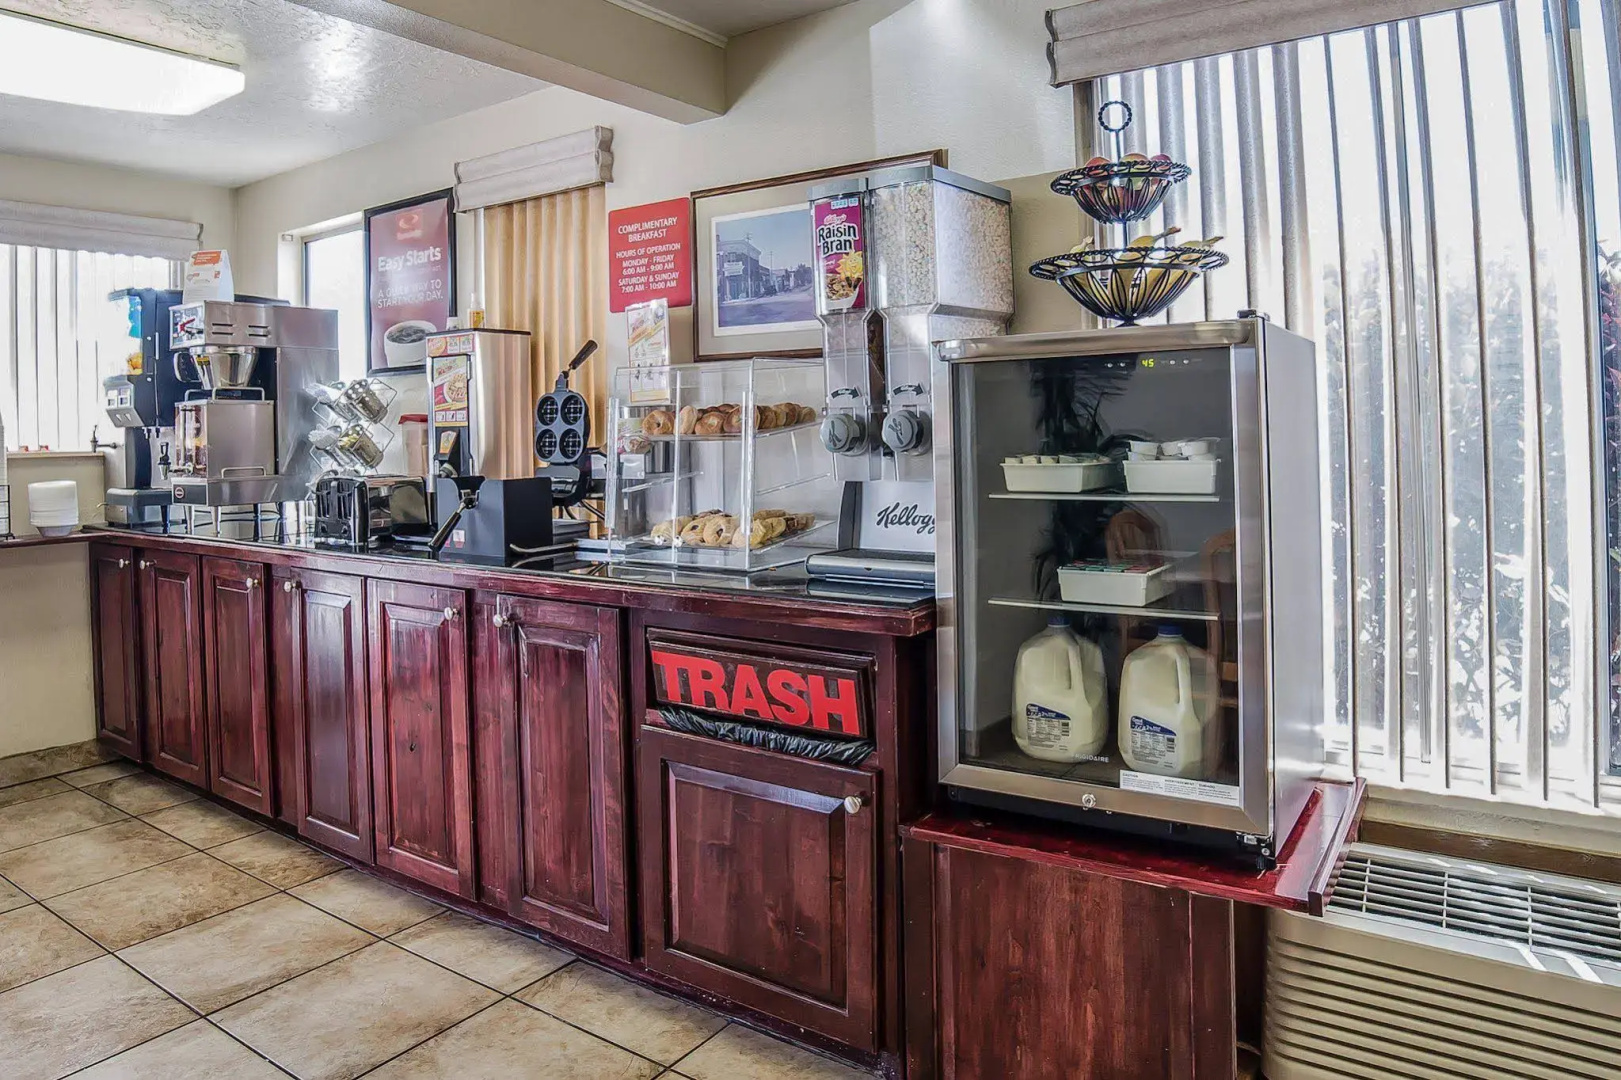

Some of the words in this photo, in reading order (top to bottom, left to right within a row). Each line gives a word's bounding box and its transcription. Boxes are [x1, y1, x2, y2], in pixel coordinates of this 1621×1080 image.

[618, 217, 677, 234] COMPLIMENTARY
[628, 229, 667, 242] BREAKFAST
[818, 224, 857, 243] Raisin
[616, 249, 636, 258] HOURS
[637, 248, 646, 256] OF
[646, 243, 681, 254] OPERATION
[822, 239, 852, 255] Bran
[377, 255, 405, 272] Easy
[406, 246, 442, 266] Starts
[622, 258, 649, 268] MONDAY
[653, 254, 675, 264] FRIDAY
[622, 267, 635, 276] 6:00
[636, 266, 646, 274] AM
[650, 264, 663, 272] 9:00
[663, 262, 674, 270] AM
[618, 276, 648, 287] SATURDAY
[654, 272, 680, 282] SUNDAY
[621, 286, 634, 294] 7:00
[634, 284, 644, 292] AM
[649, 282, 665, 290] 10:00
[665, 280, 677, 288] AM
[378, 289, 384, 298] A
[430, 278, 442, 289] TO
[378, 296, 402, 309] START
[426, 289, 444, 301] DAY.
[1142, 358, 1154, 367] 45
[651, 650, 860, 735] TRASH
